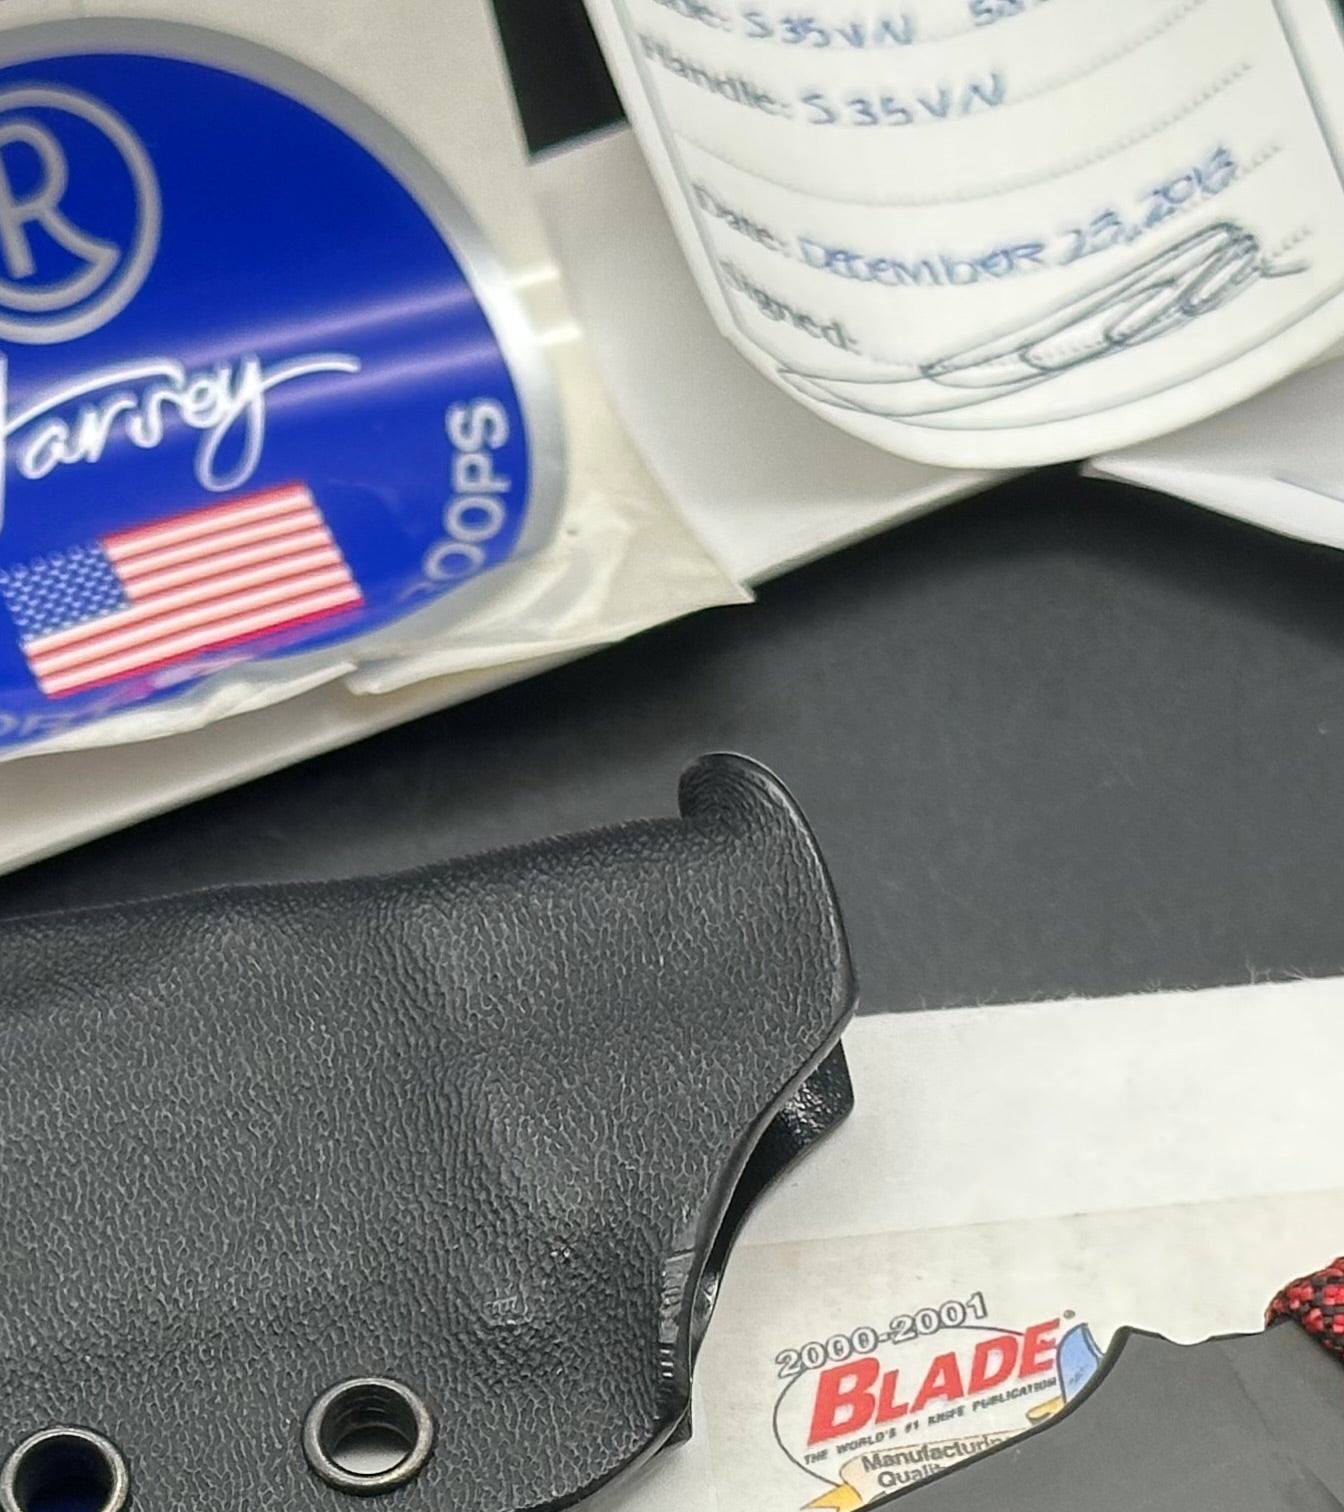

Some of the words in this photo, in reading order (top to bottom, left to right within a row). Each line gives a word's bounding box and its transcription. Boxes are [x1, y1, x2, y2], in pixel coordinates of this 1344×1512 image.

[775, 1291, 988, 1380] 2000-2001
[804, 1449, 828, 1466] THE
[836, 1428, 898, 1455] WORLD'S
[928, 1404, 966, 1427] KNIFE
[973, 1376, 1058, 1413] PUBLICATION
[807, 1317, 1060, 1447] BLADE
